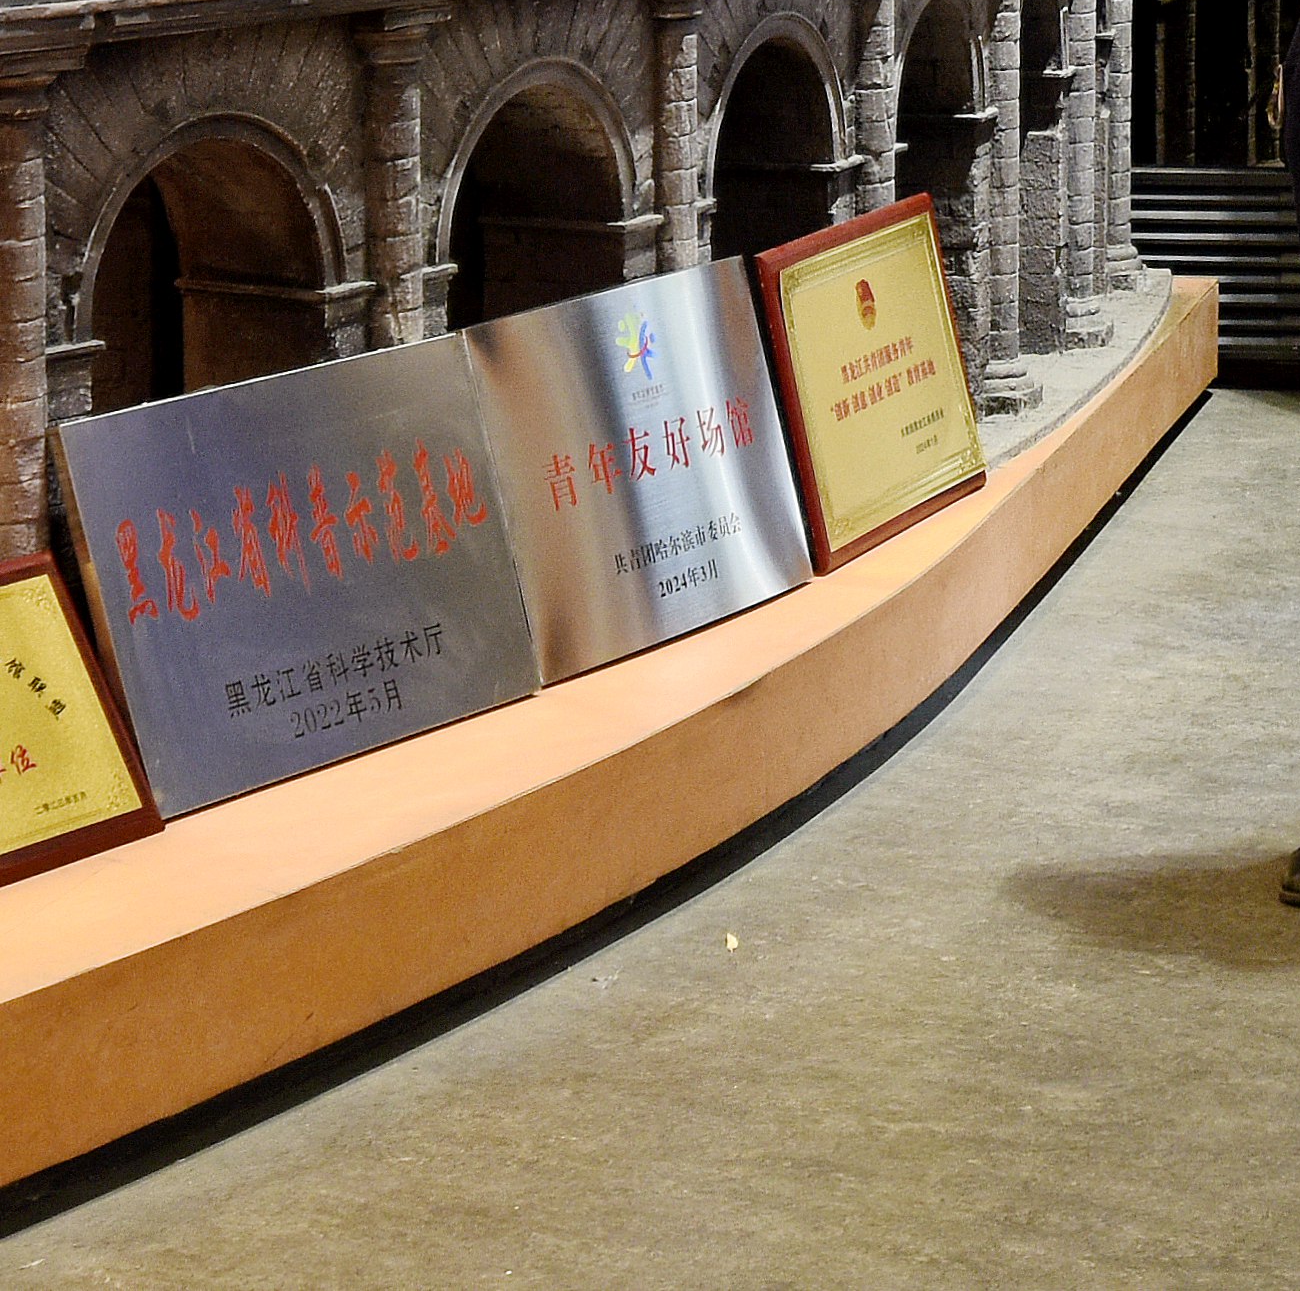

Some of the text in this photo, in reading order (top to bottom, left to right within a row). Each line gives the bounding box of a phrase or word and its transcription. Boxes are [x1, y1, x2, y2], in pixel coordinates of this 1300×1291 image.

[542, 397, 755, 511] 青年友好场馆
[116, 438, 489, 625] 黑龙江省科普示范基地
[614, 512, 742, 575] 共青团哈尔滨市委员会
[658, 559, 719, 598] 2024年3月
[225, 623, 443, 717] 黑龙江省科学技术厅
[290, 679, 402, 739] 2022年5月
